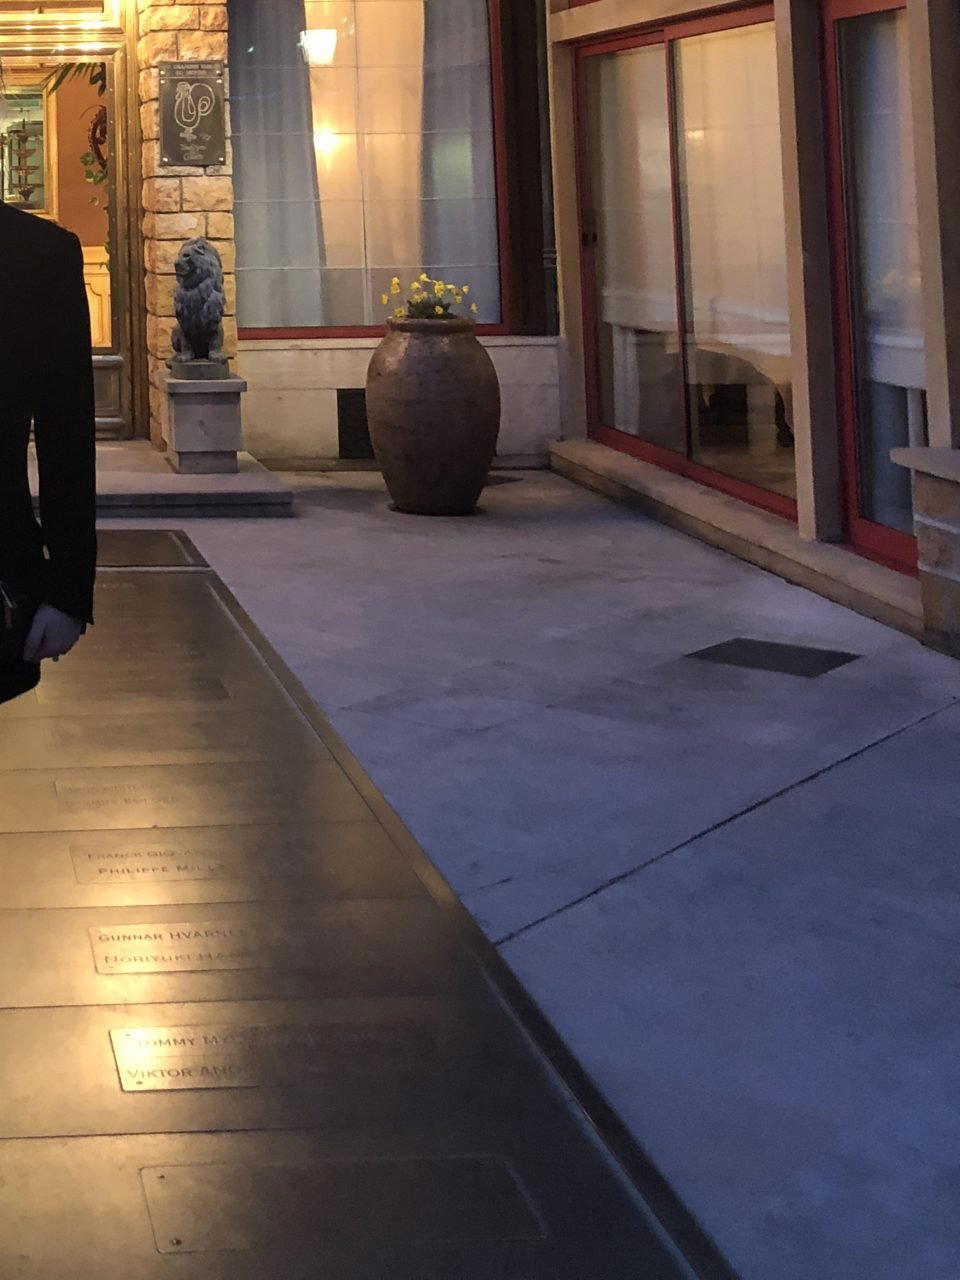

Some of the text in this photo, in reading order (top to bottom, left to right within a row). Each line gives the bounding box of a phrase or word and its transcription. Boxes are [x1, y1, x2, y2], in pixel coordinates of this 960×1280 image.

[98, 866, 170, 875] PHILIPPE
[98, 933, 163, 942] GUNNAR
[127, 1066, 193, 1078] VIKTOR
